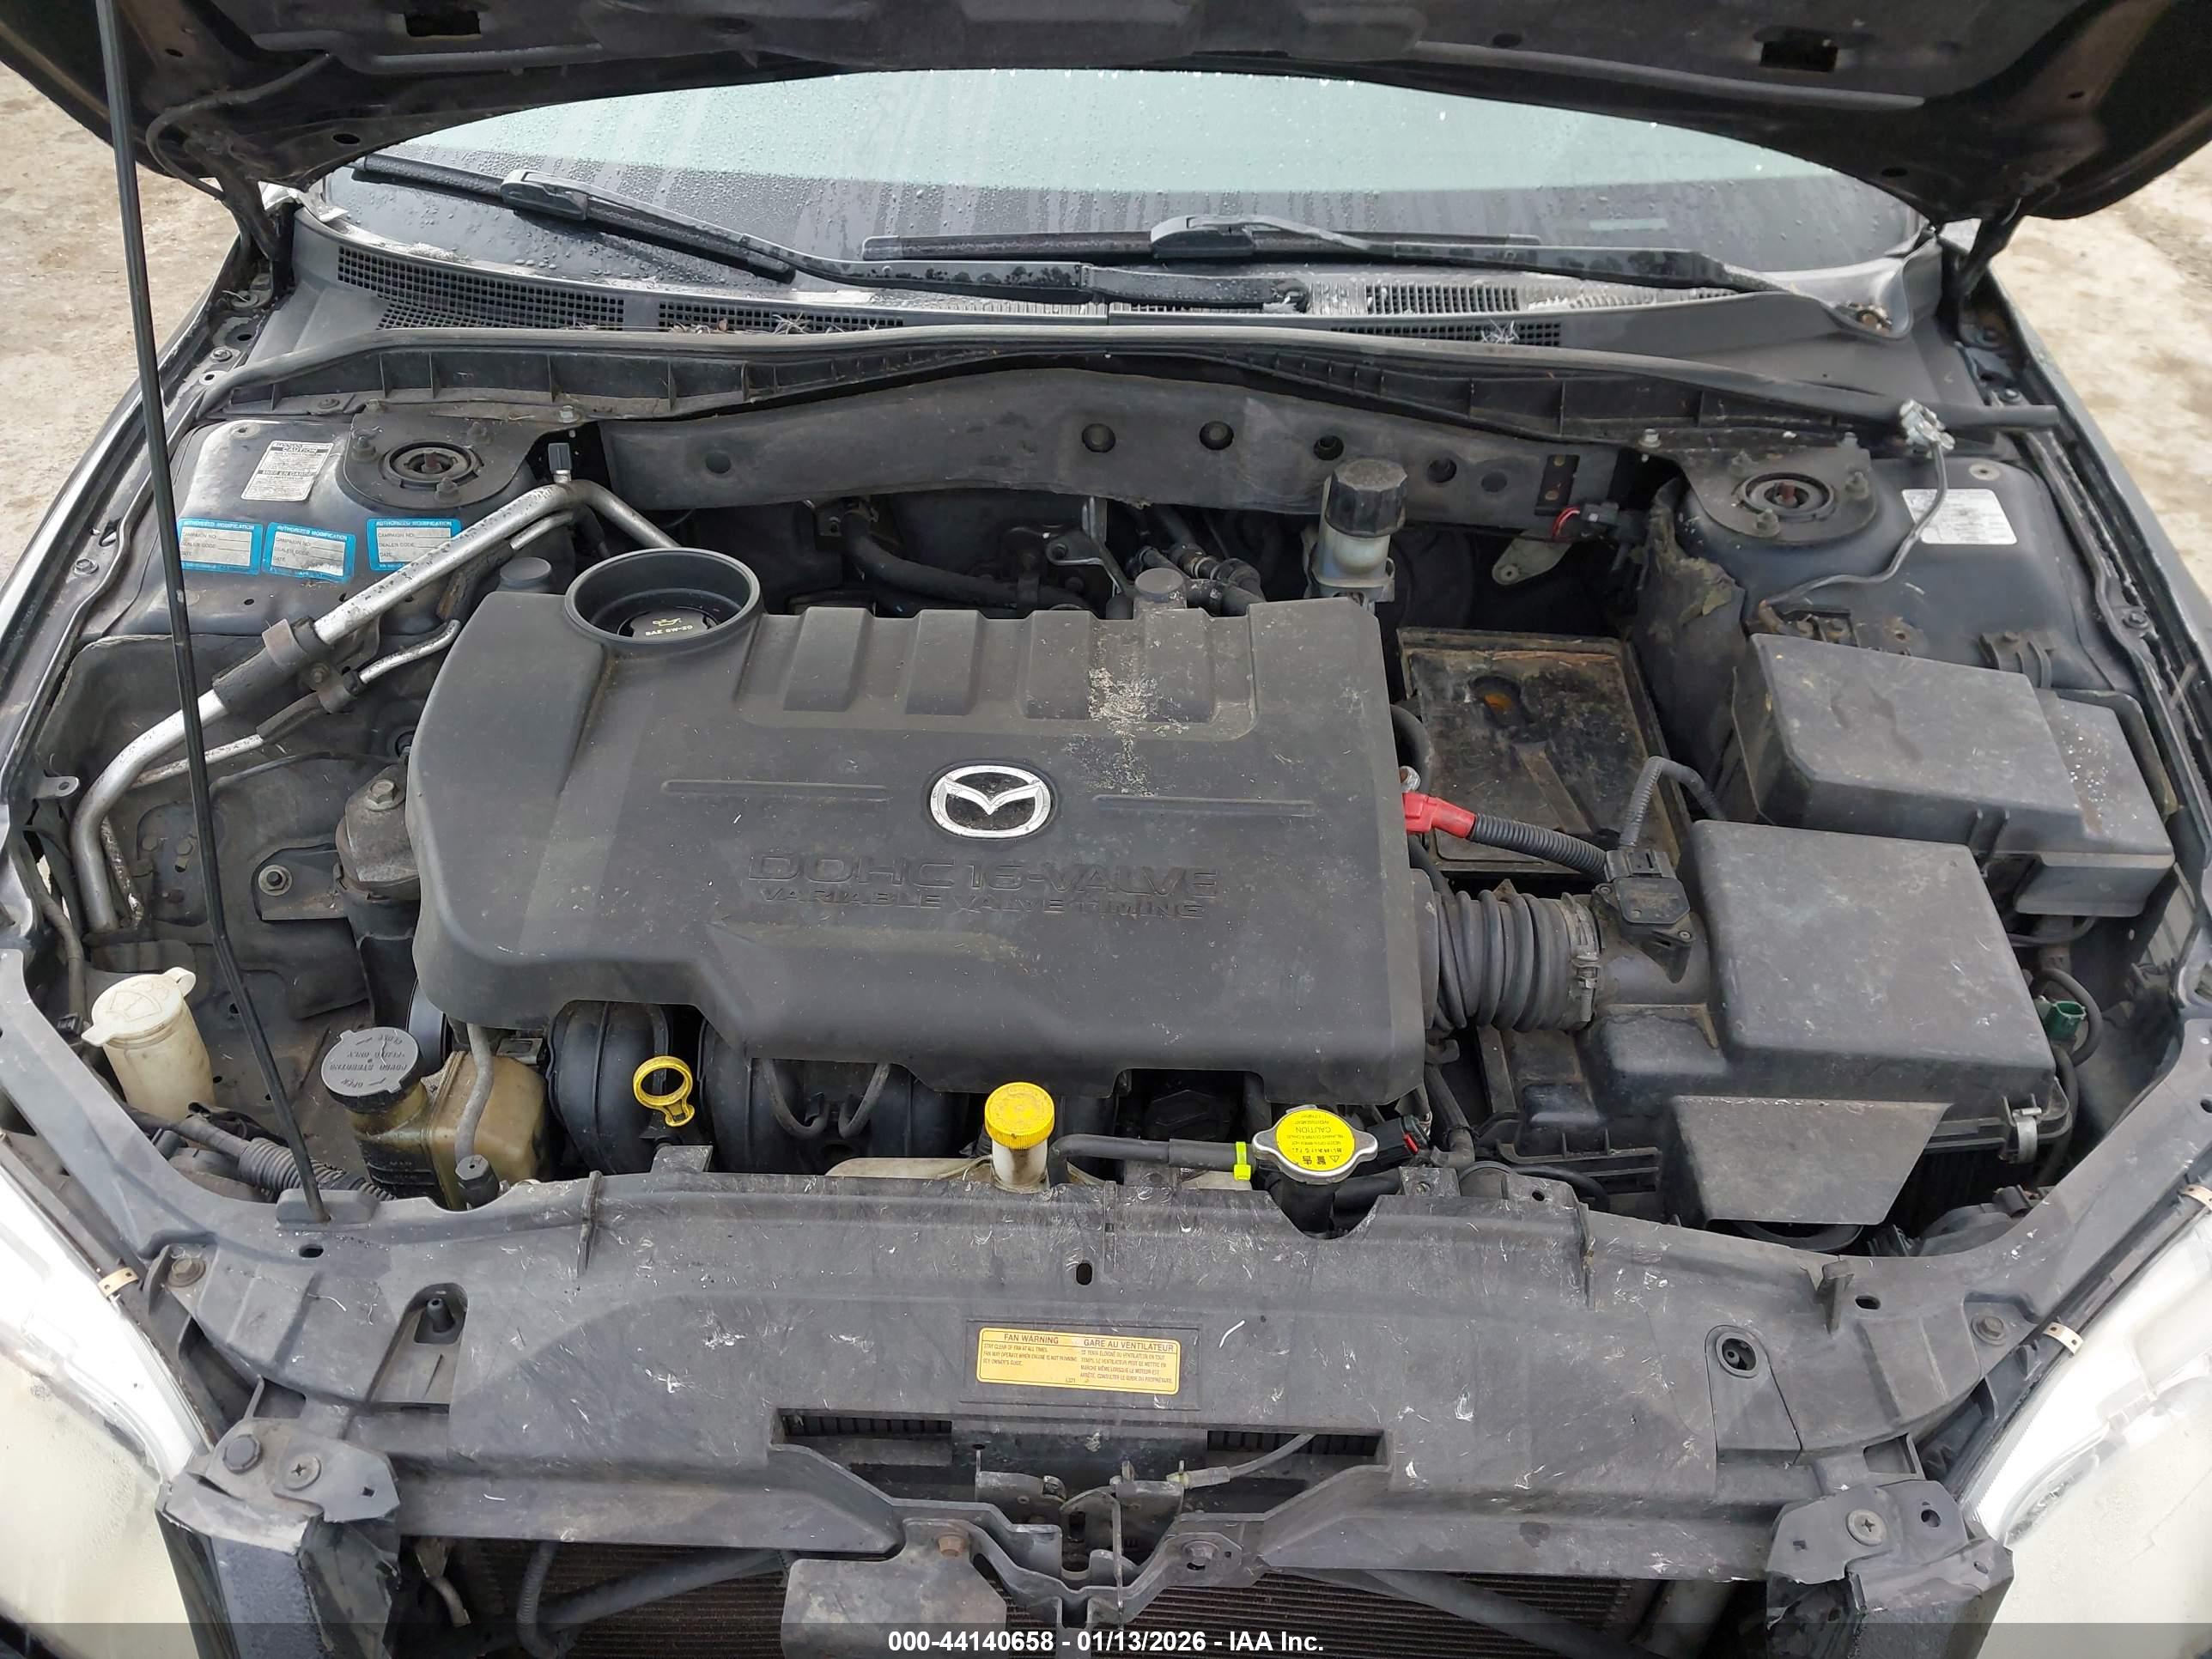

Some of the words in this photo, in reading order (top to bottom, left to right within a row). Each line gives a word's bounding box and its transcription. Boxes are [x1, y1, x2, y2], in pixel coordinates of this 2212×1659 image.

[747, 854, 957, 890] DOHC
[966, 863, 1218, 899] 16-VALVE
[759, 886, 942, 909] VARIABLE
[952, 895, 1066, 914] VALVE
[1069, 901, 1204, 919] TIMING
[340, 1078, 364, 1089] OPEN
[1004, 1333, 1019, 1342] FAN
[1021, 1334, 1059, 1345] WARNING
[1084, 1339, 1106, 1348] GARE
[1108, 1340, 1120, 1348] AU
[1121, 1340, 1174, 1352] VENTILATEUR
